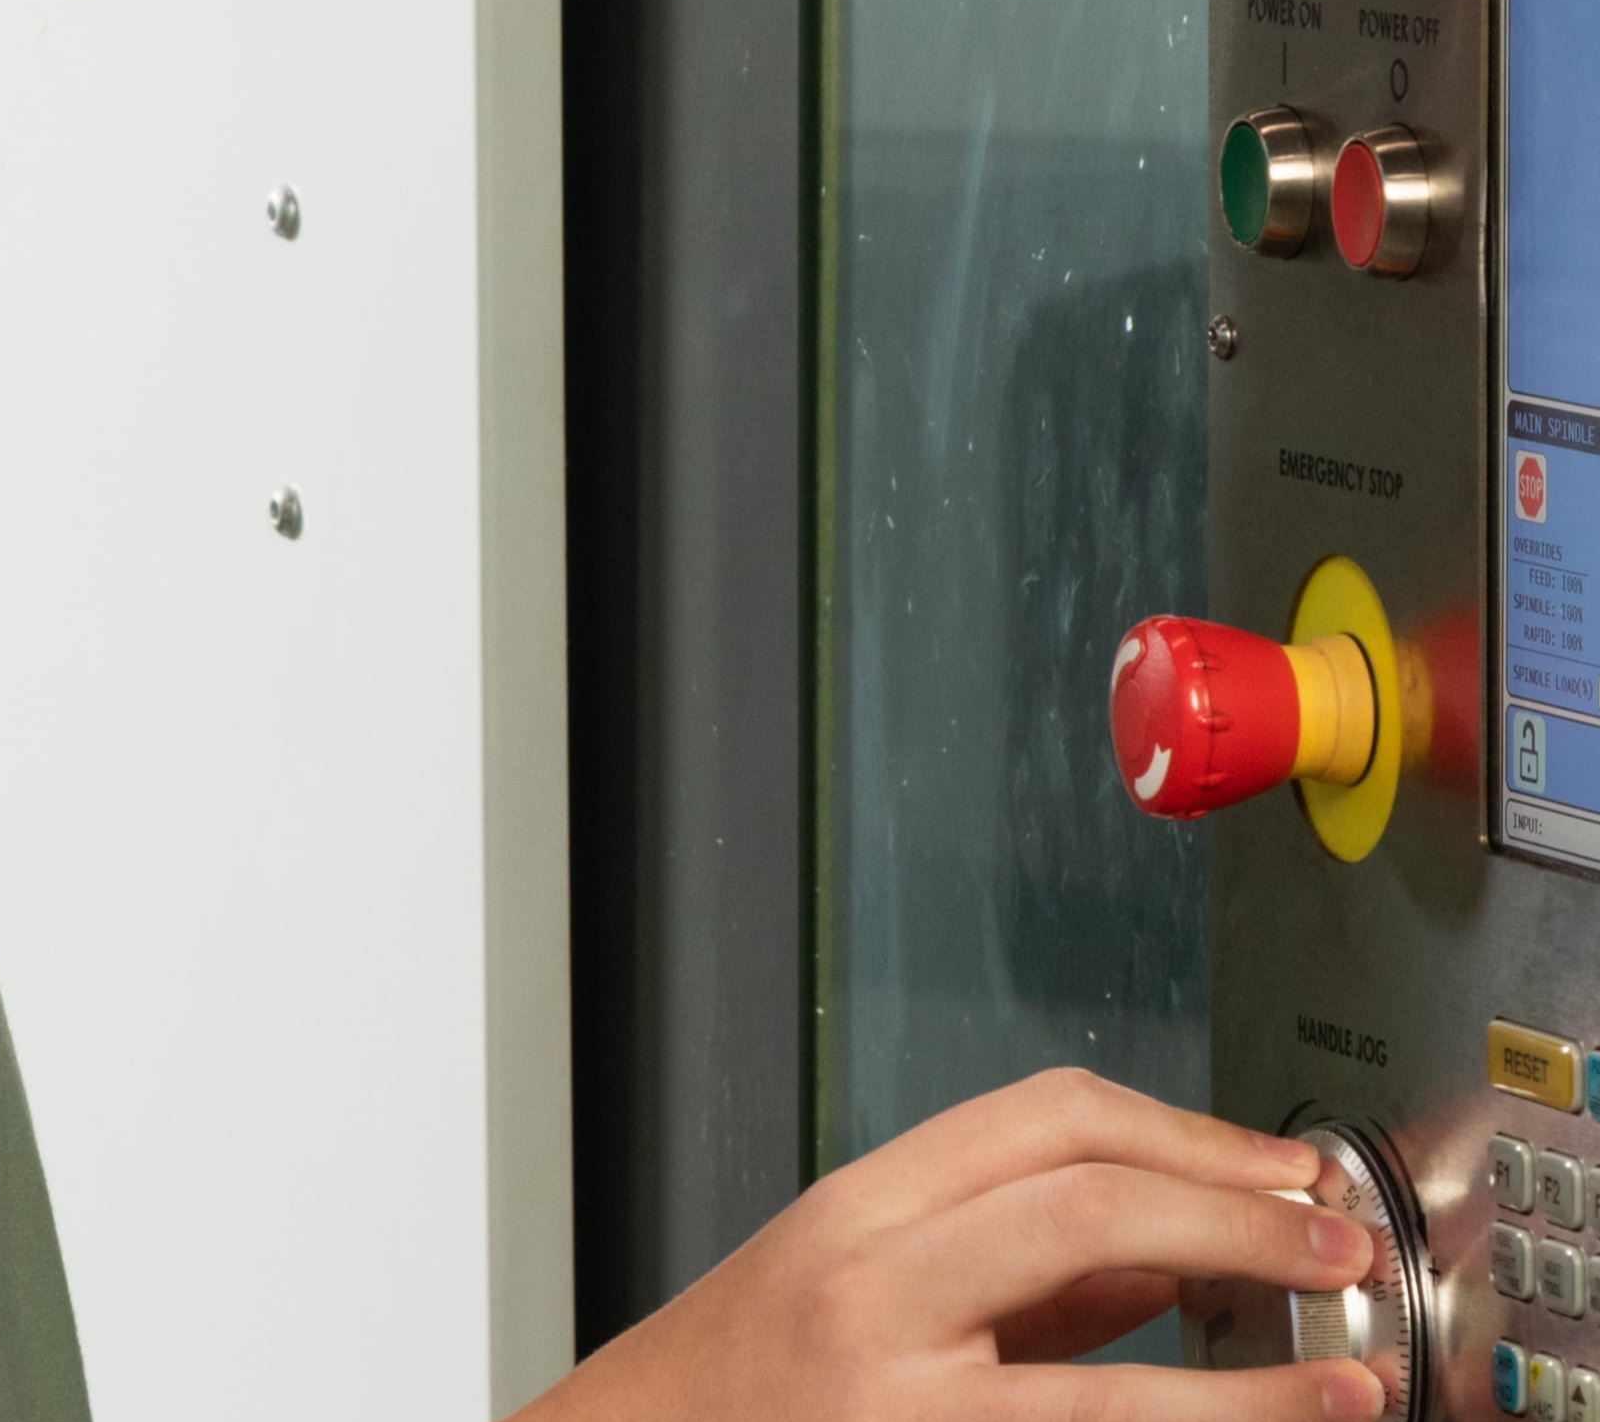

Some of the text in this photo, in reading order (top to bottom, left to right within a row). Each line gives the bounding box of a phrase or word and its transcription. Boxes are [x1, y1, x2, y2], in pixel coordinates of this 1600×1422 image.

[1300, 0, 1321, 29] ON
[1360, 8, 1439, 46] POWER OFF
[1515, 411, 1595, 446] MAIN SPINDLE
[1279, 449, 1403, 499] EMERGENCY STOP
[1519, 474, 1542, 499] STOP
[1513, 537, 1562, 562] OVERRIDES
[1529, 569, 1583, 595] FEED: 100%
[1513, 594, 1583, 623] SPINDLE: 100%
[1524, 625, 1583, 652] RAPID: 100%
[1513, 665, 1593, 700] SPINDLE LOAD(%)
[1513, 812, 1543, 836] INPUT:
[1298, 1014, 1387, 1068] HANDLE JOG
[1504, 1047, 1550, 1085] RESET
[1496, 1160, 1510, 1187] F1
[1342, 1185, 1361, 1211] 50
[1544, 1177, 1561, 1206] F2
